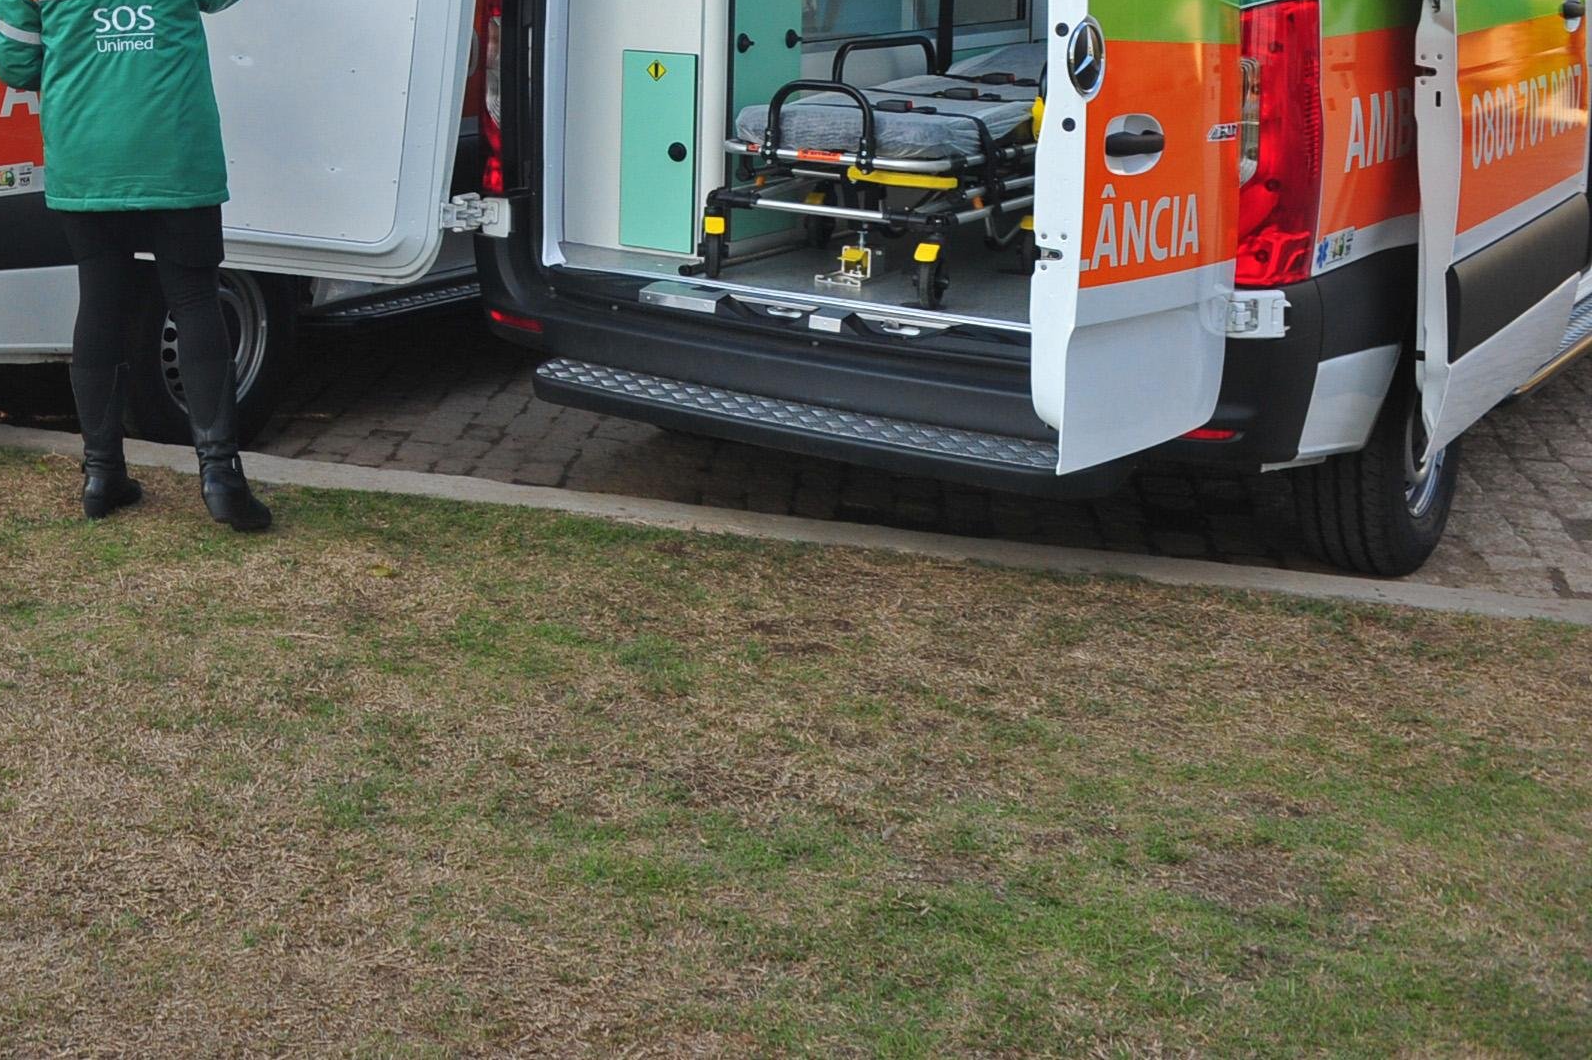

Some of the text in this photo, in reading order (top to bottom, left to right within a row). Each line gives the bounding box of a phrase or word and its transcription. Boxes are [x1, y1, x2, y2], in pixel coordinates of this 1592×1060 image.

[93, 5, 156, 33] SOS
[97, 37, 154, 53] Unimed
[1472, 84, 1516, 170] 0800
[1518, 75, 1548, 151] 707
